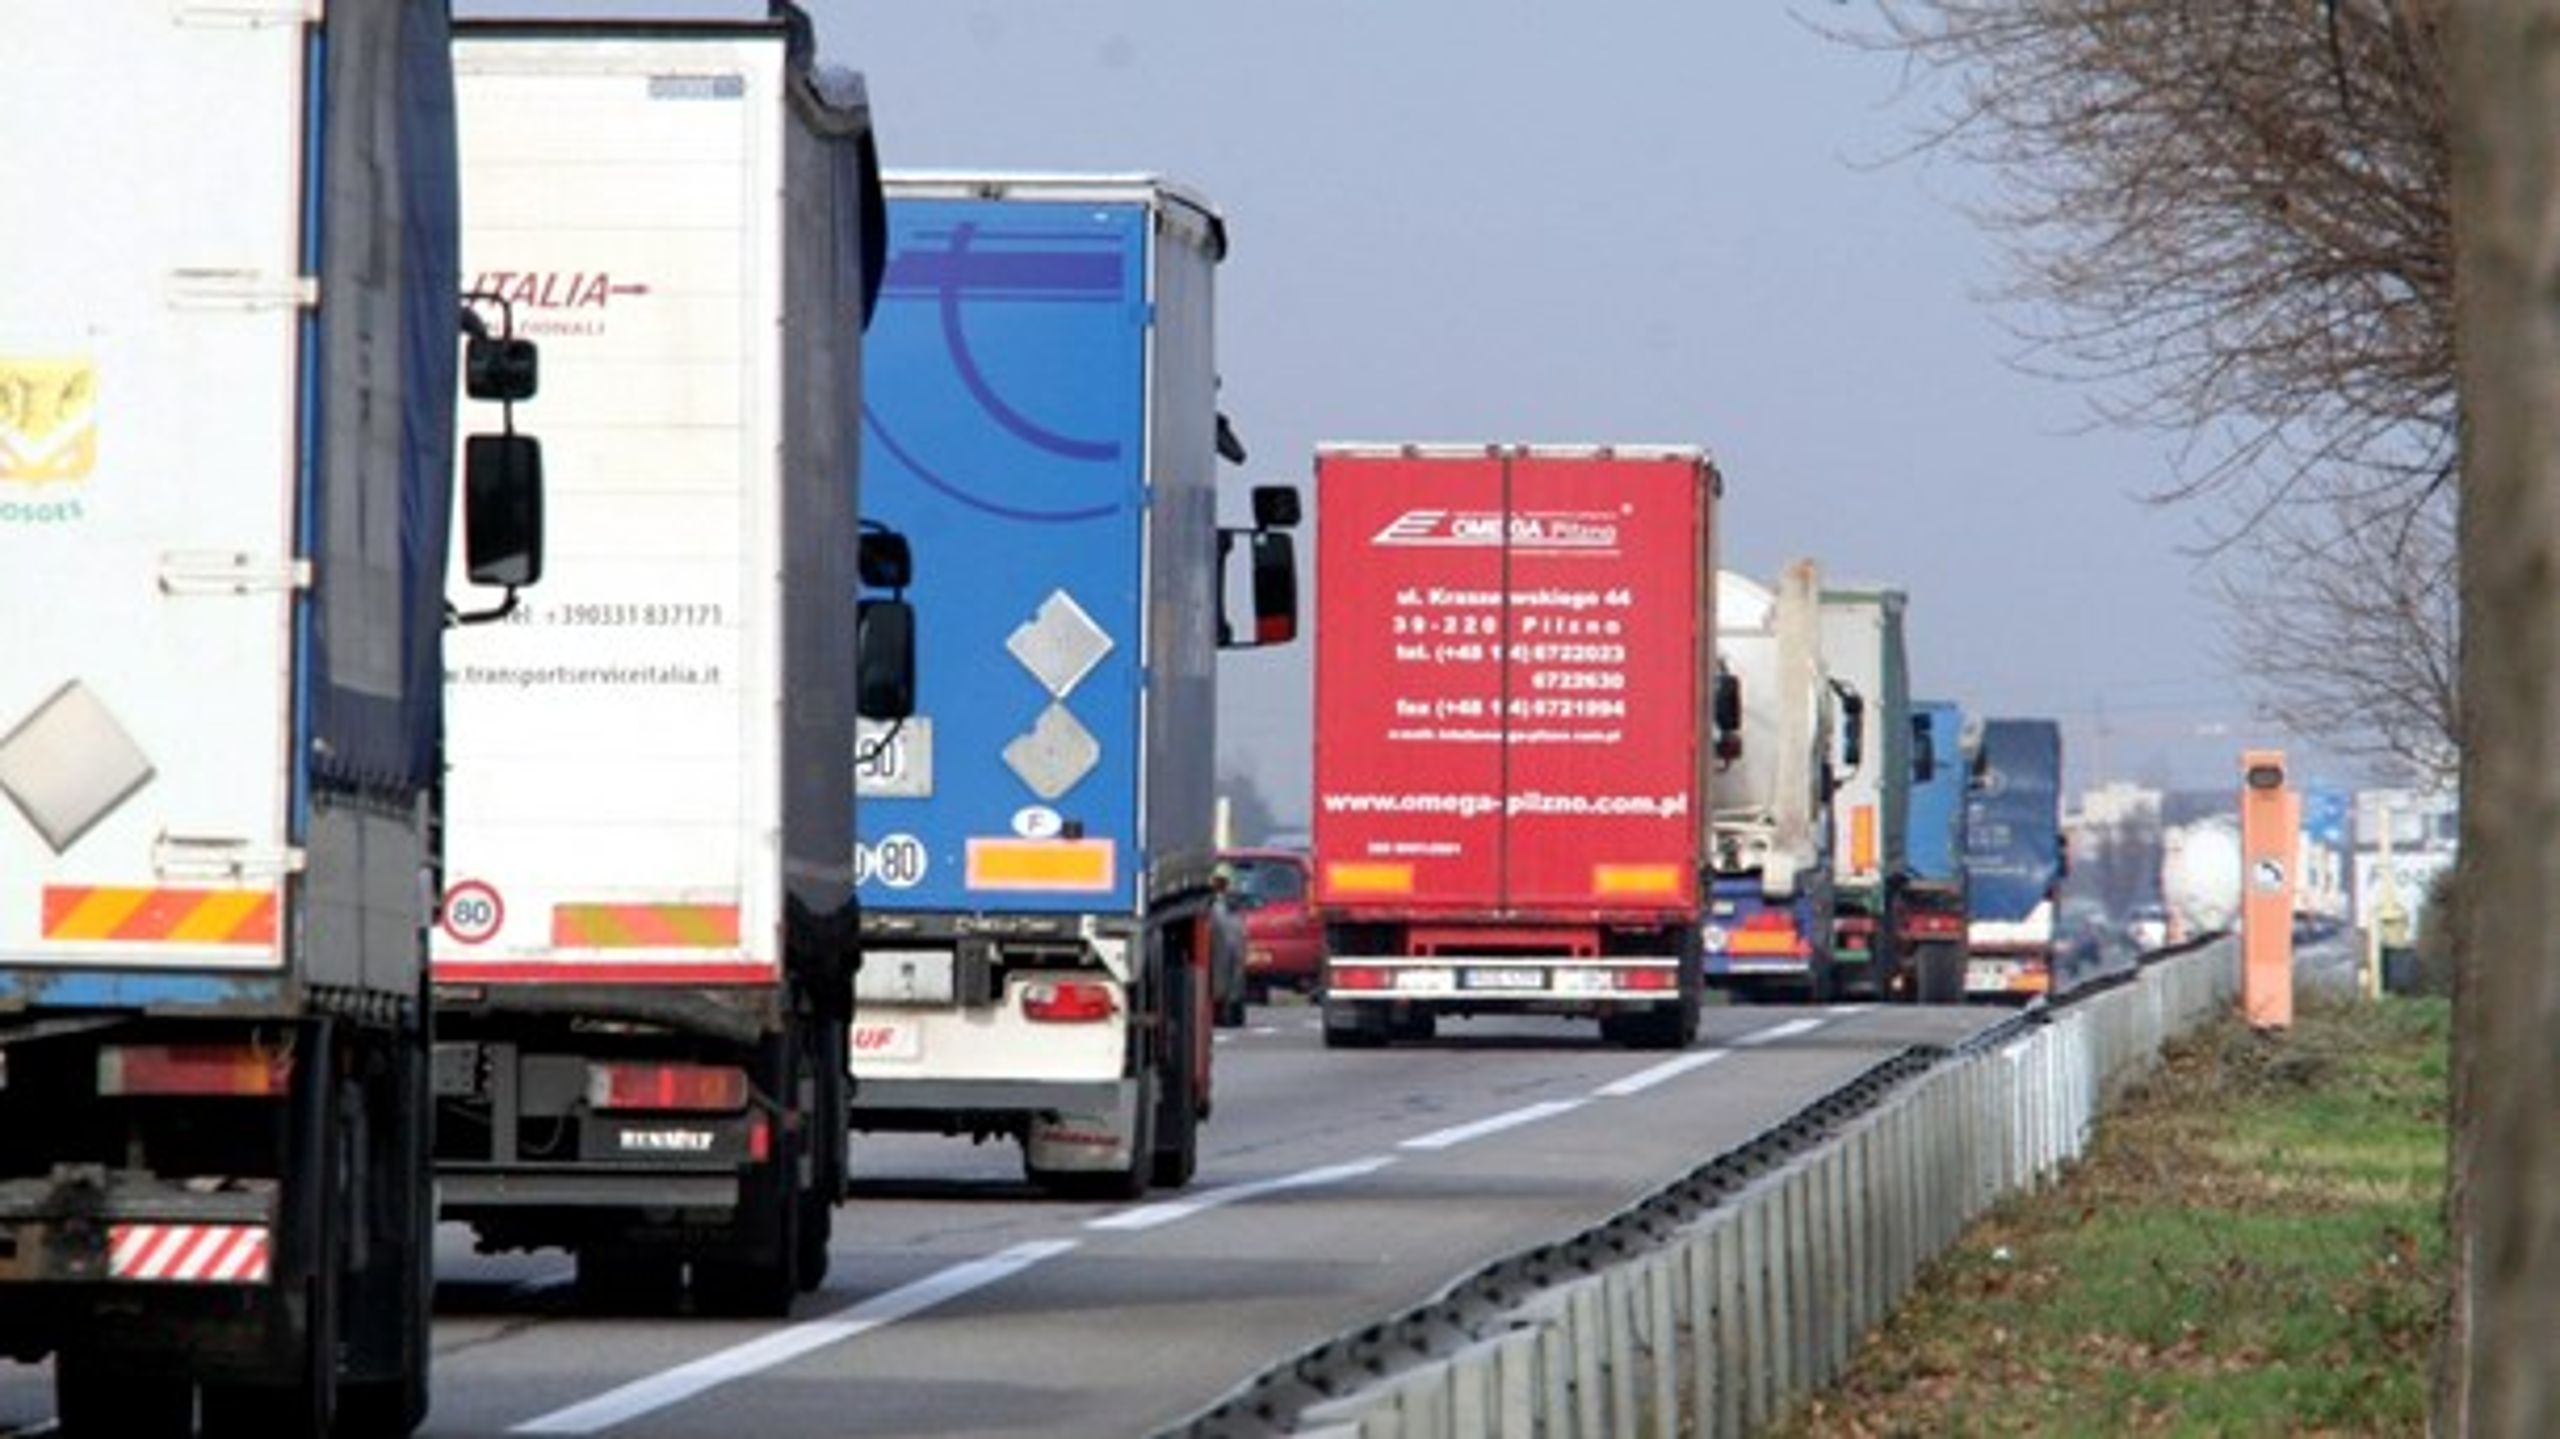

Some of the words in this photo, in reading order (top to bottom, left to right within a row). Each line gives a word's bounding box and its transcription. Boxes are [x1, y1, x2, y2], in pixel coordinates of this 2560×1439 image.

[470, 266, 610, 308] ITALIA
[1451, 518, 1542, 538] OMEGA
[1393, 615, 1497, 635] 39-220
[1521, 616, 1622, 635] Pilzno
[1325, 791, 1688, 818] www.omega-pilzno.com.pl
[882, 842, 918, 882] 80
[453, 897, 492, 924] 80
